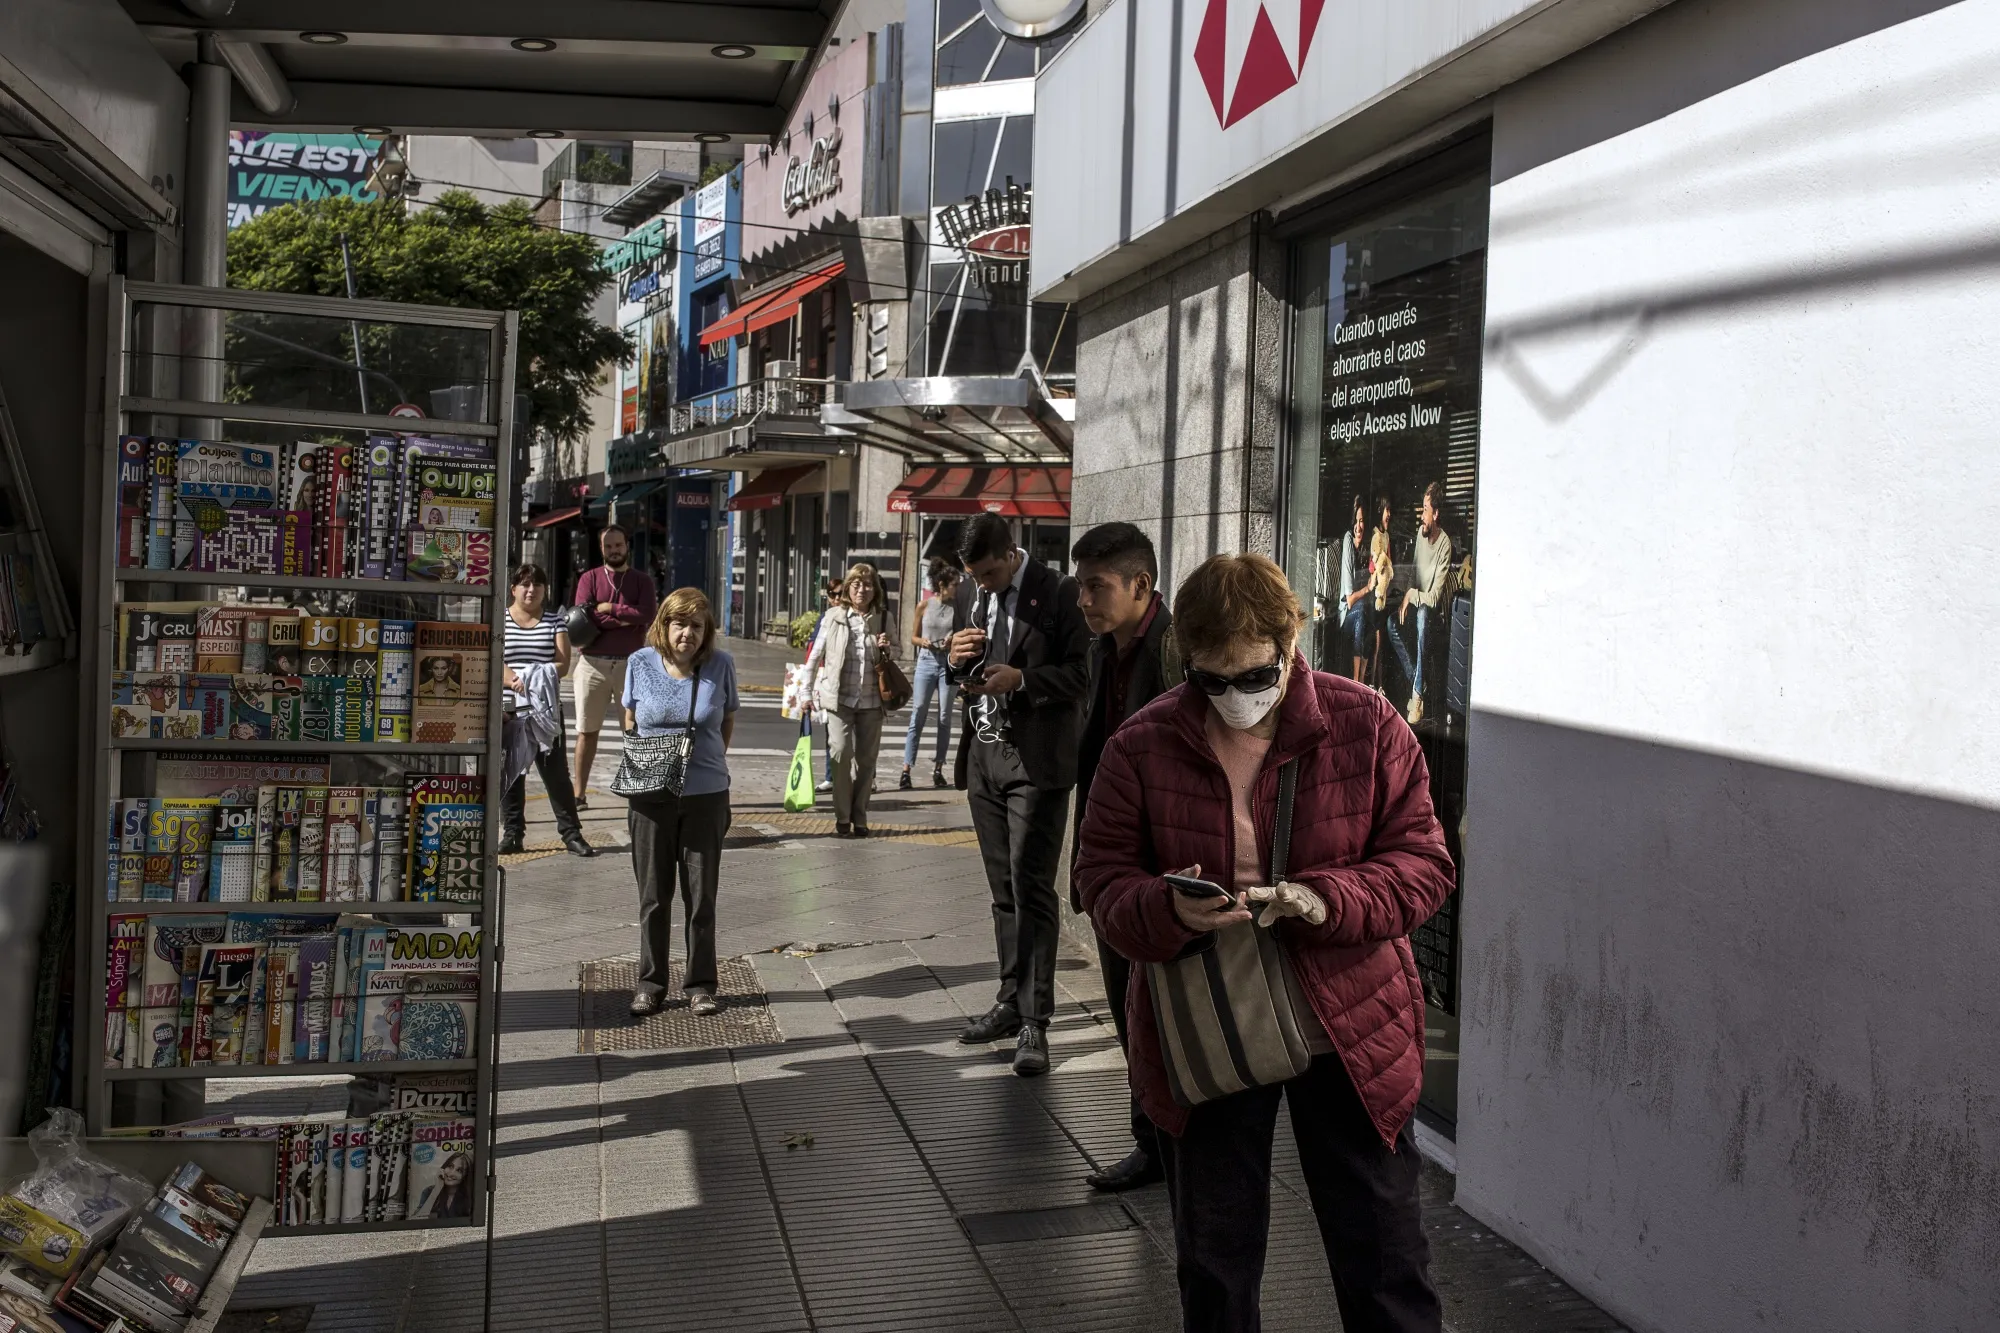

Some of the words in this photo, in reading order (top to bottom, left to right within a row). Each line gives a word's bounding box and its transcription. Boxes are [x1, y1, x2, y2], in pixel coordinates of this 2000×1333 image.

[1334, 315, 1374, 345] Cuando
[1378, 302, 1417, 337] querés
[1333, 349, 1381, 377] ahorrarte
[1384, 341, 1394, 365] el
[1398, 339, 1426, 362] caos
[1332, 385, 1347, 408] del
[1350, 377, 1414, 405] aeropuerto,
[1331, 415, 1361, 443] elegís
[1363, 412, 1406, 436] Access
[1410, 404, 1442, 428] Now
[251, 453, 264, 464] 68
[181, 458, 273, 487] Platino
[181, 482, 273, 500] EXTRA
[677, 495, 710, 505] ALQUILA
[381, 718, 392, 729] 68
[162, 752, 204, 760] DIBUJOS
[223, 766, 252, 780] DE
[255, 766, 326, 783] COLOR
[182, 860, 198, 869] 64
[111, 953, 128, 987] Súper
[391, 962, 437, 970] MANDALAS
[426, 981, 475, 992] MANDALAS
